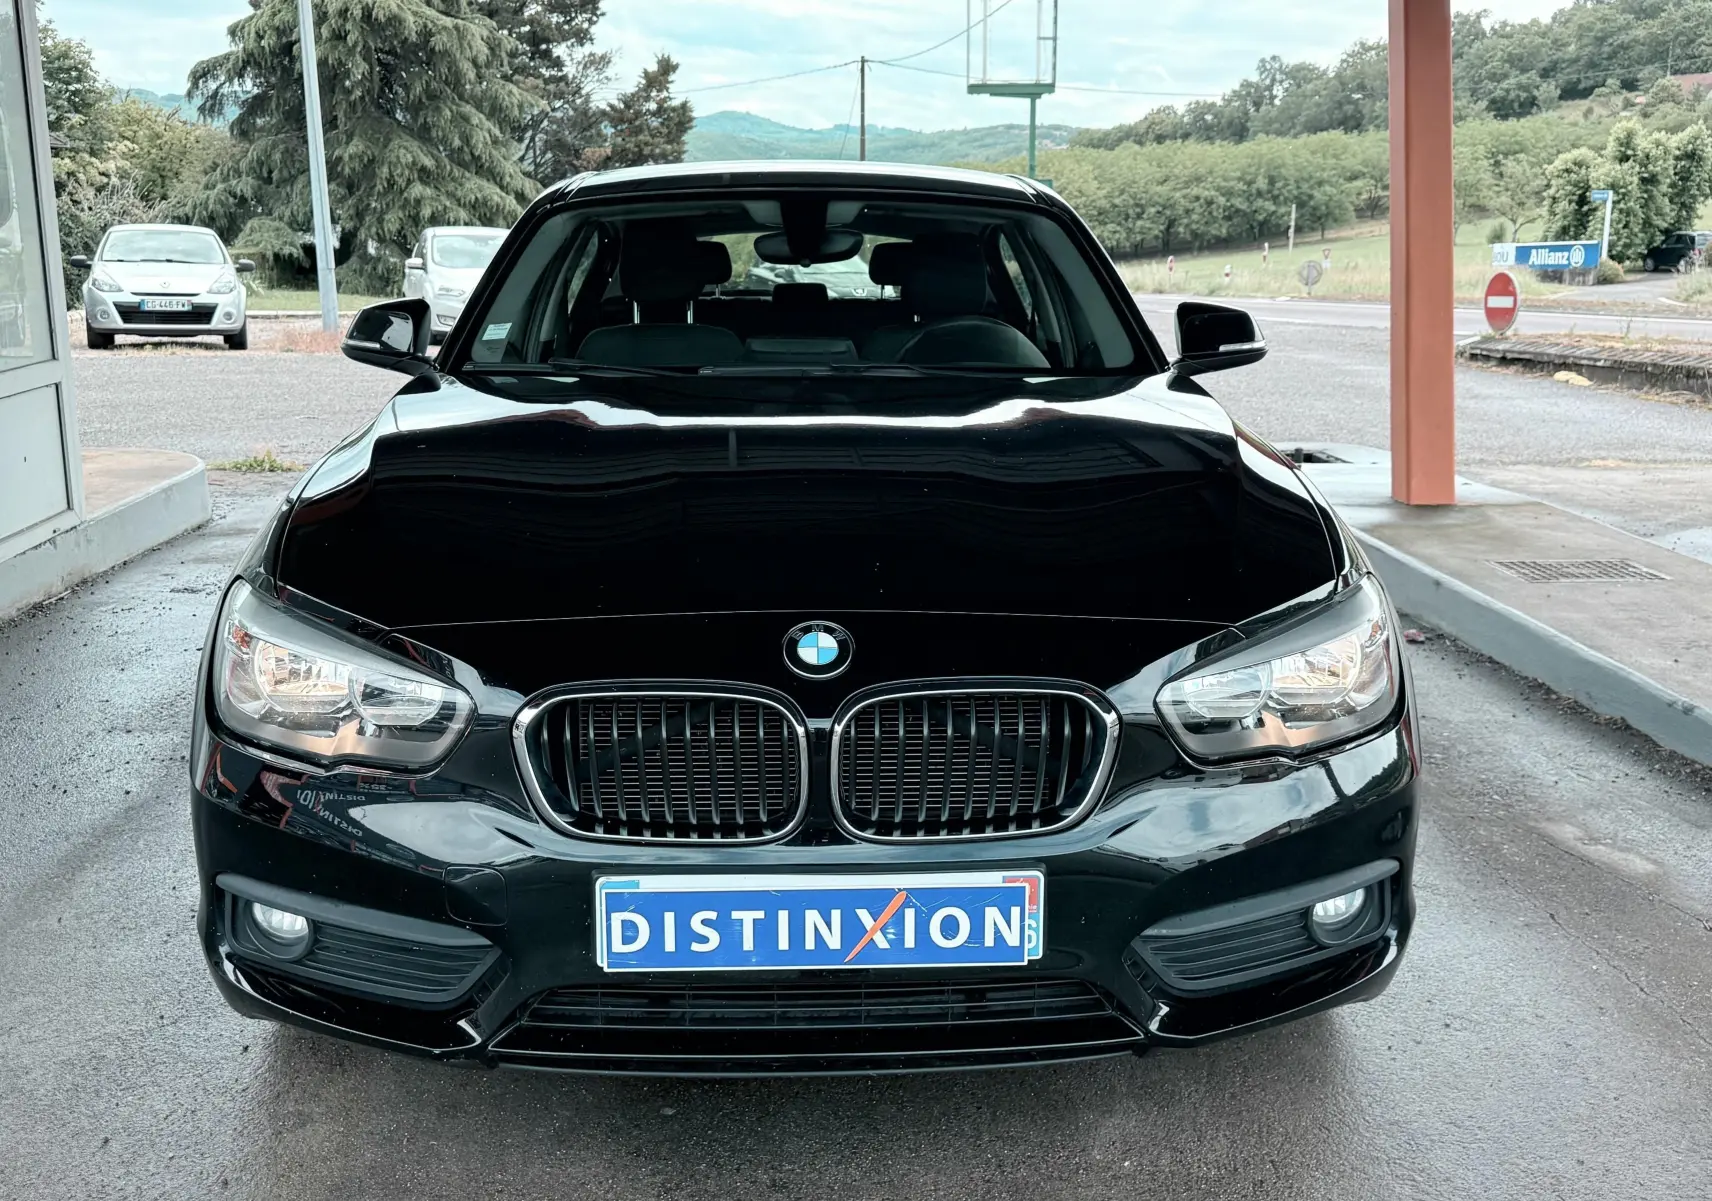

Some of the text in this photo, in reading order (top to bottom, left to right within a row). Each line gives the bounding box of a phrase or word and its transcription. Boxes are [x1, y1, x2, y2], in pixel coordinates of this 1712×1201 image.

[1528, 248, 1569, 265] Allianz
[791, 624, 846, 641] BMW
[609, 891, 1022, 964] DISTINXION
